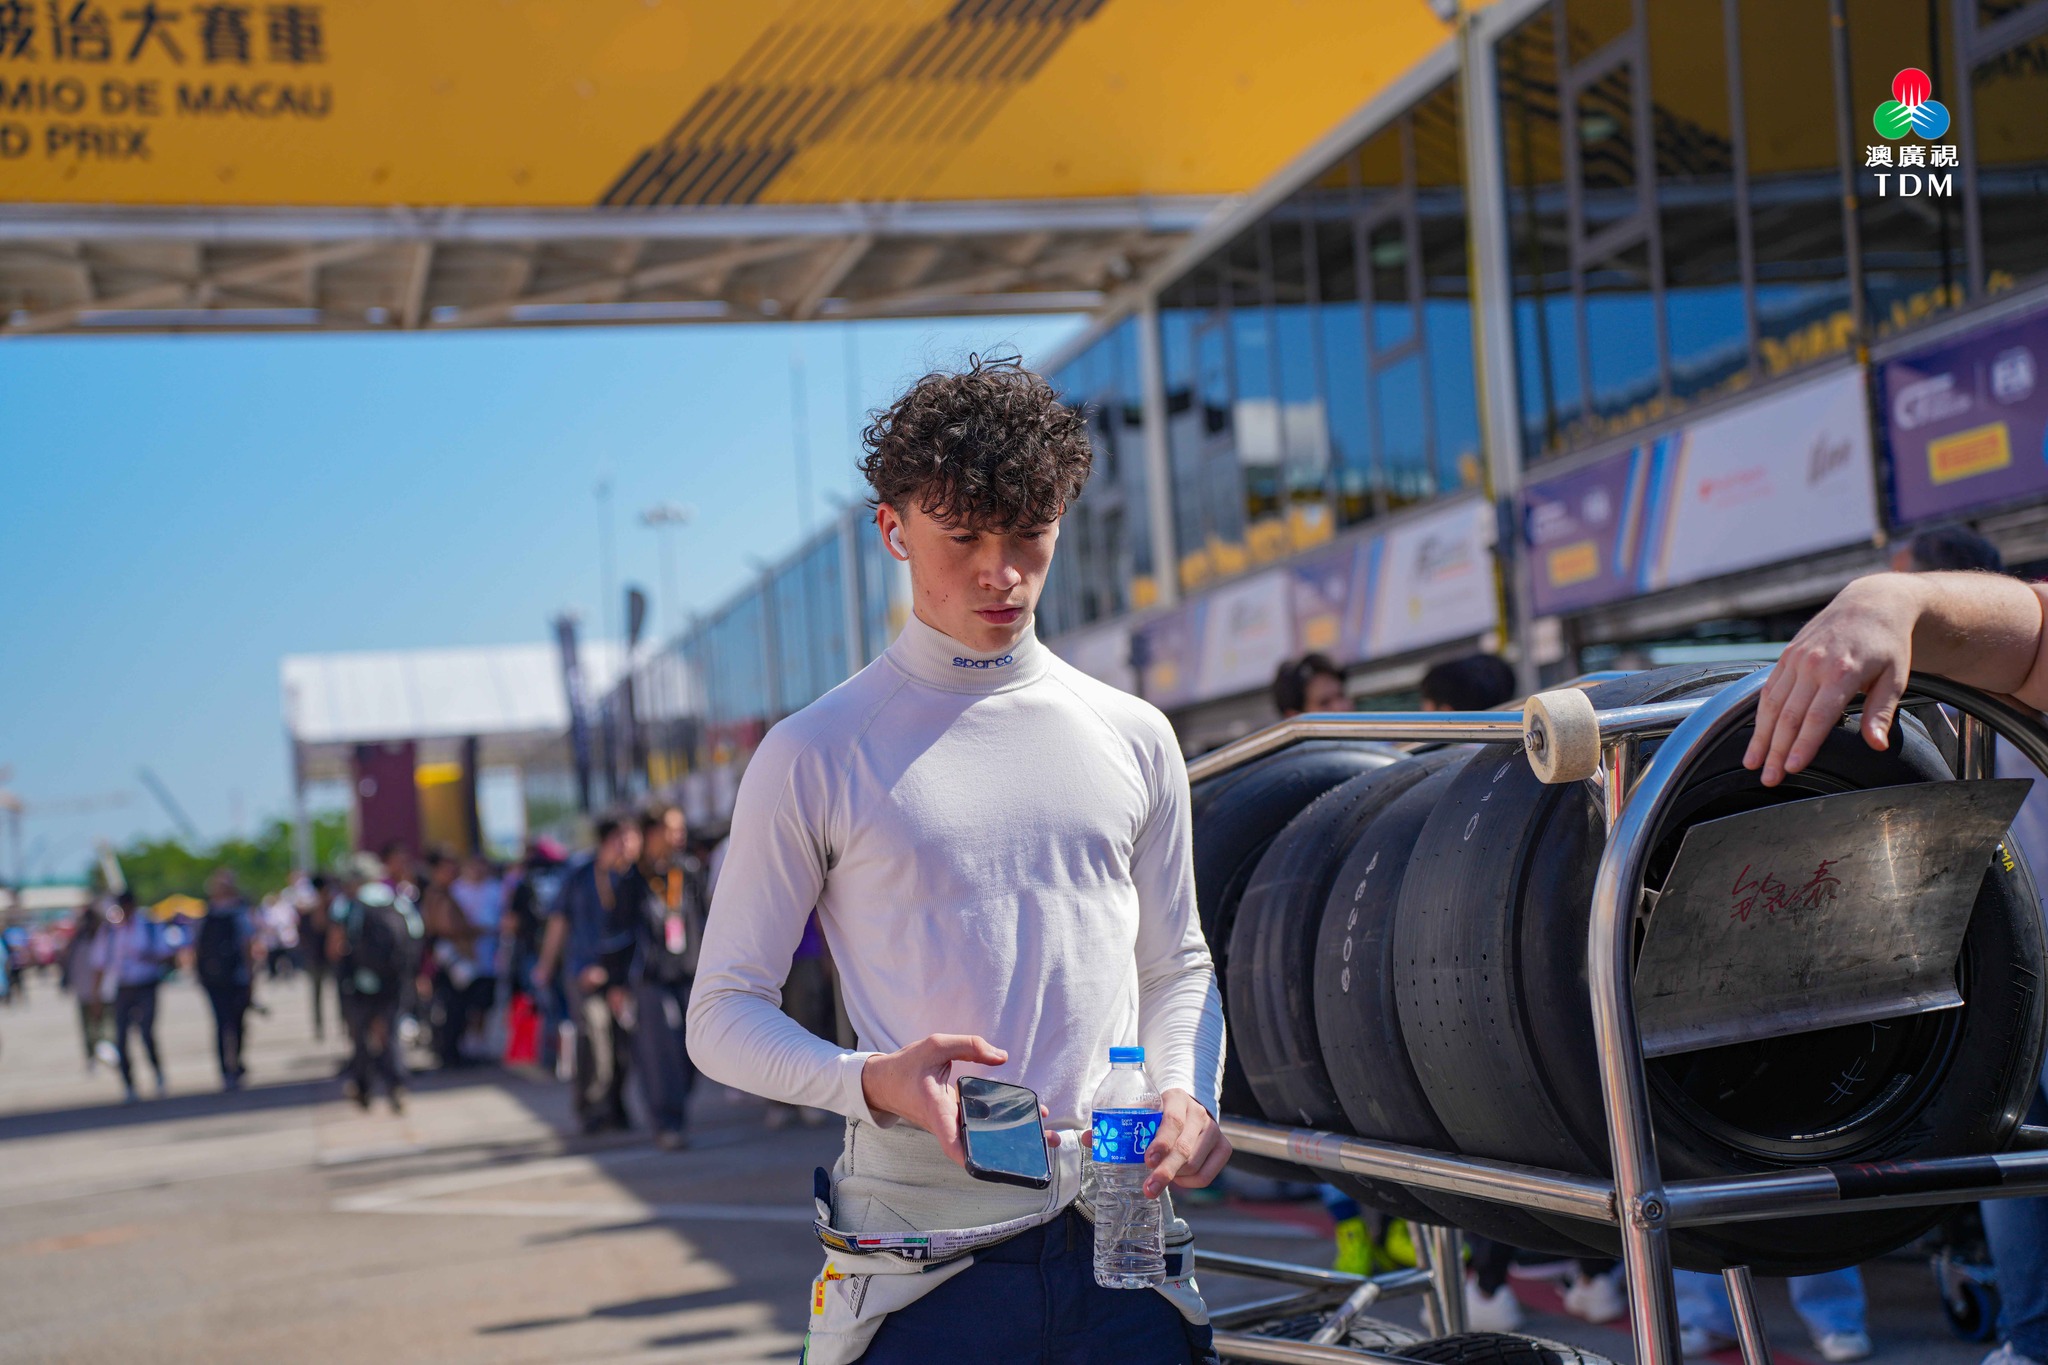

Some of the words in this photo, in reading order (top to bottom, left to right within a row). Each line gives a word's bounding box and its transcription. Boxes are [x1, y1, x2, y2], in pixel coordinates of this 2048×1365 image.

[100, 79, 161, 117] DE
[176, 82, 333, 120] MACAU
[46, 125, 152, 161] PRIX
[952, 654, 1013, 669] sparco
